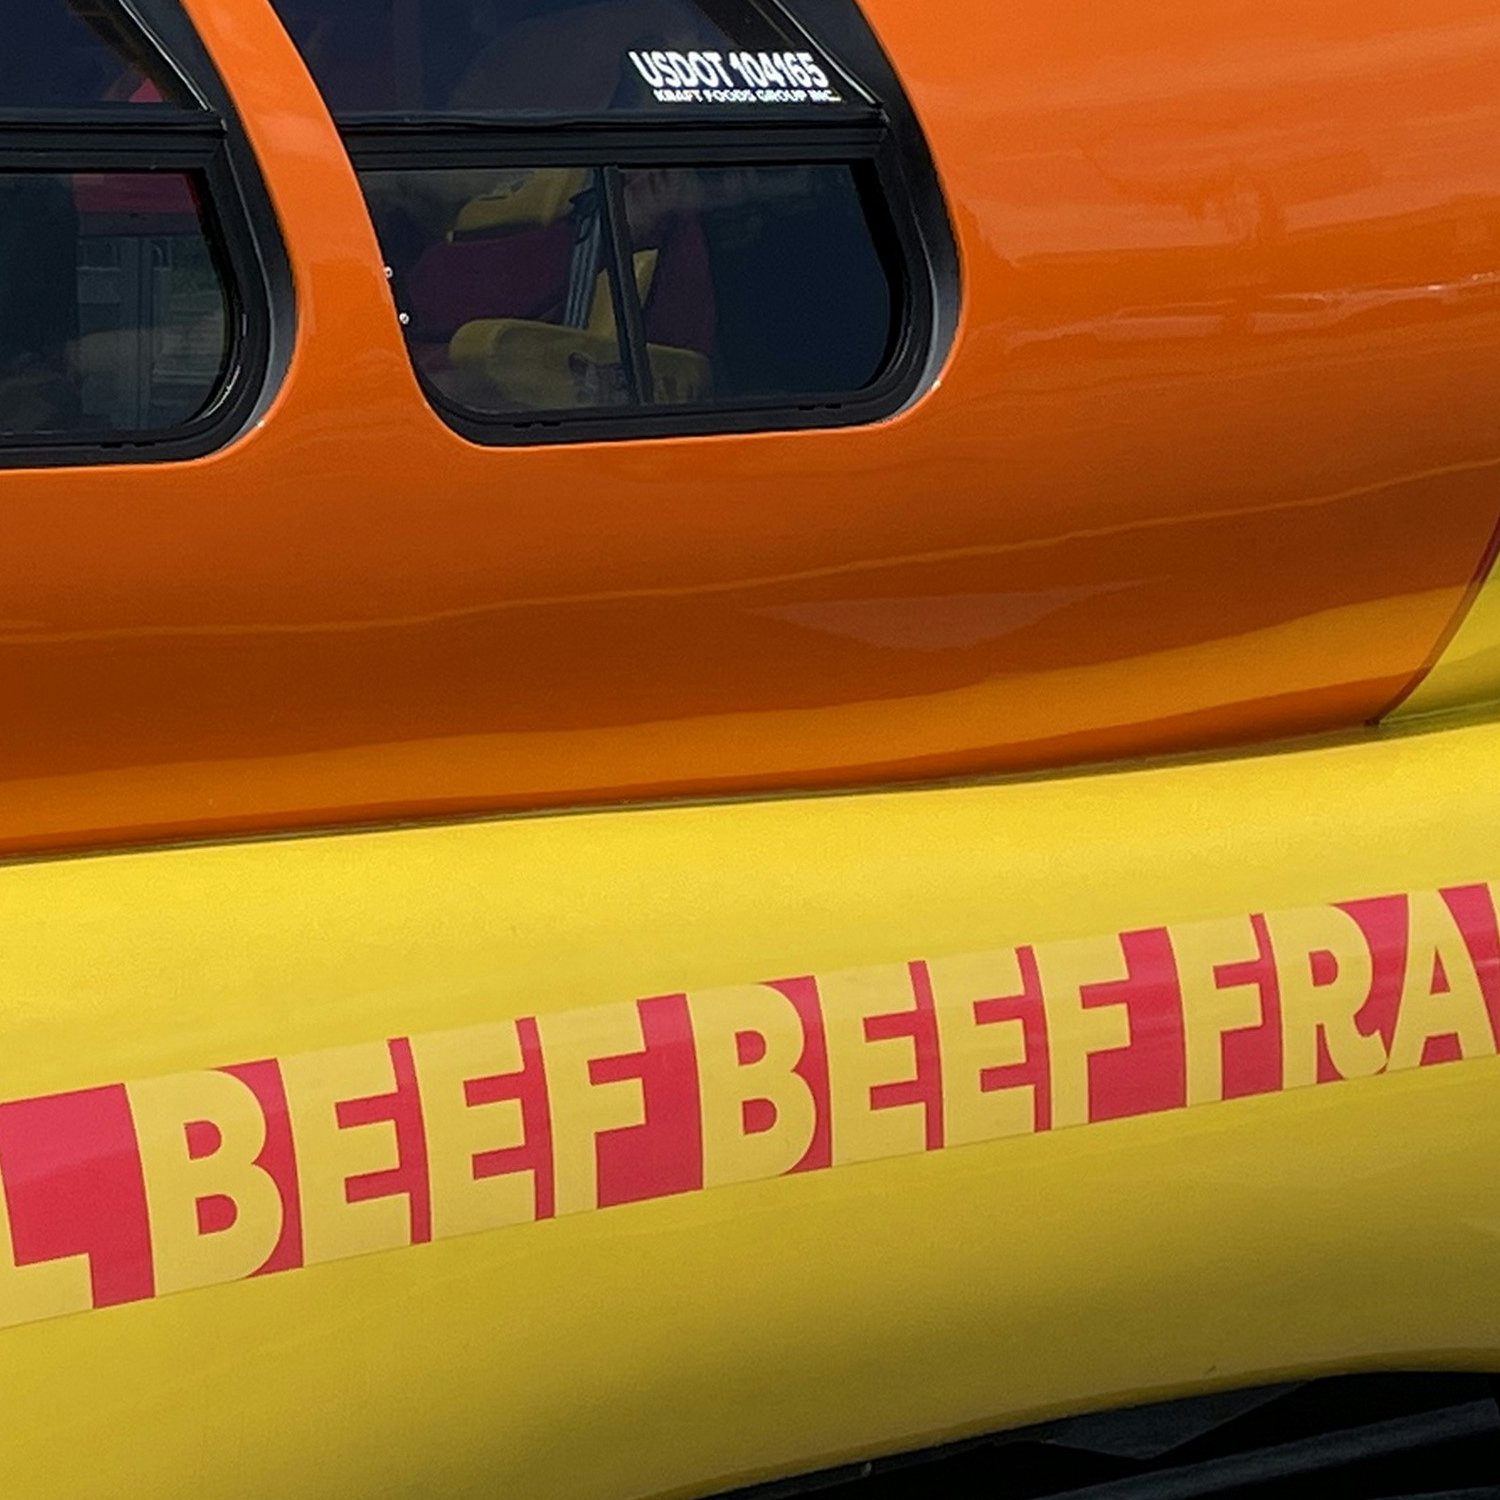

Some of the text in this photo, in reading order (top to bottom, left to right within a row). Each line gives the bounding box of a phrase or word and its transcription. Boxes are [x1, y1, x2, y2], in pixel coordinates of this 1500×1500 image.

[628, 51, 829, 88] USDOT 104165
[653, 89, 701, 102] KRAFT
[702, 90, 756, 102] FOODS
[756, 90, 807, 102] GROUP
[127, 995, 647, 1297] BEEF
[686, 930, 1130, 1190] BEEF
